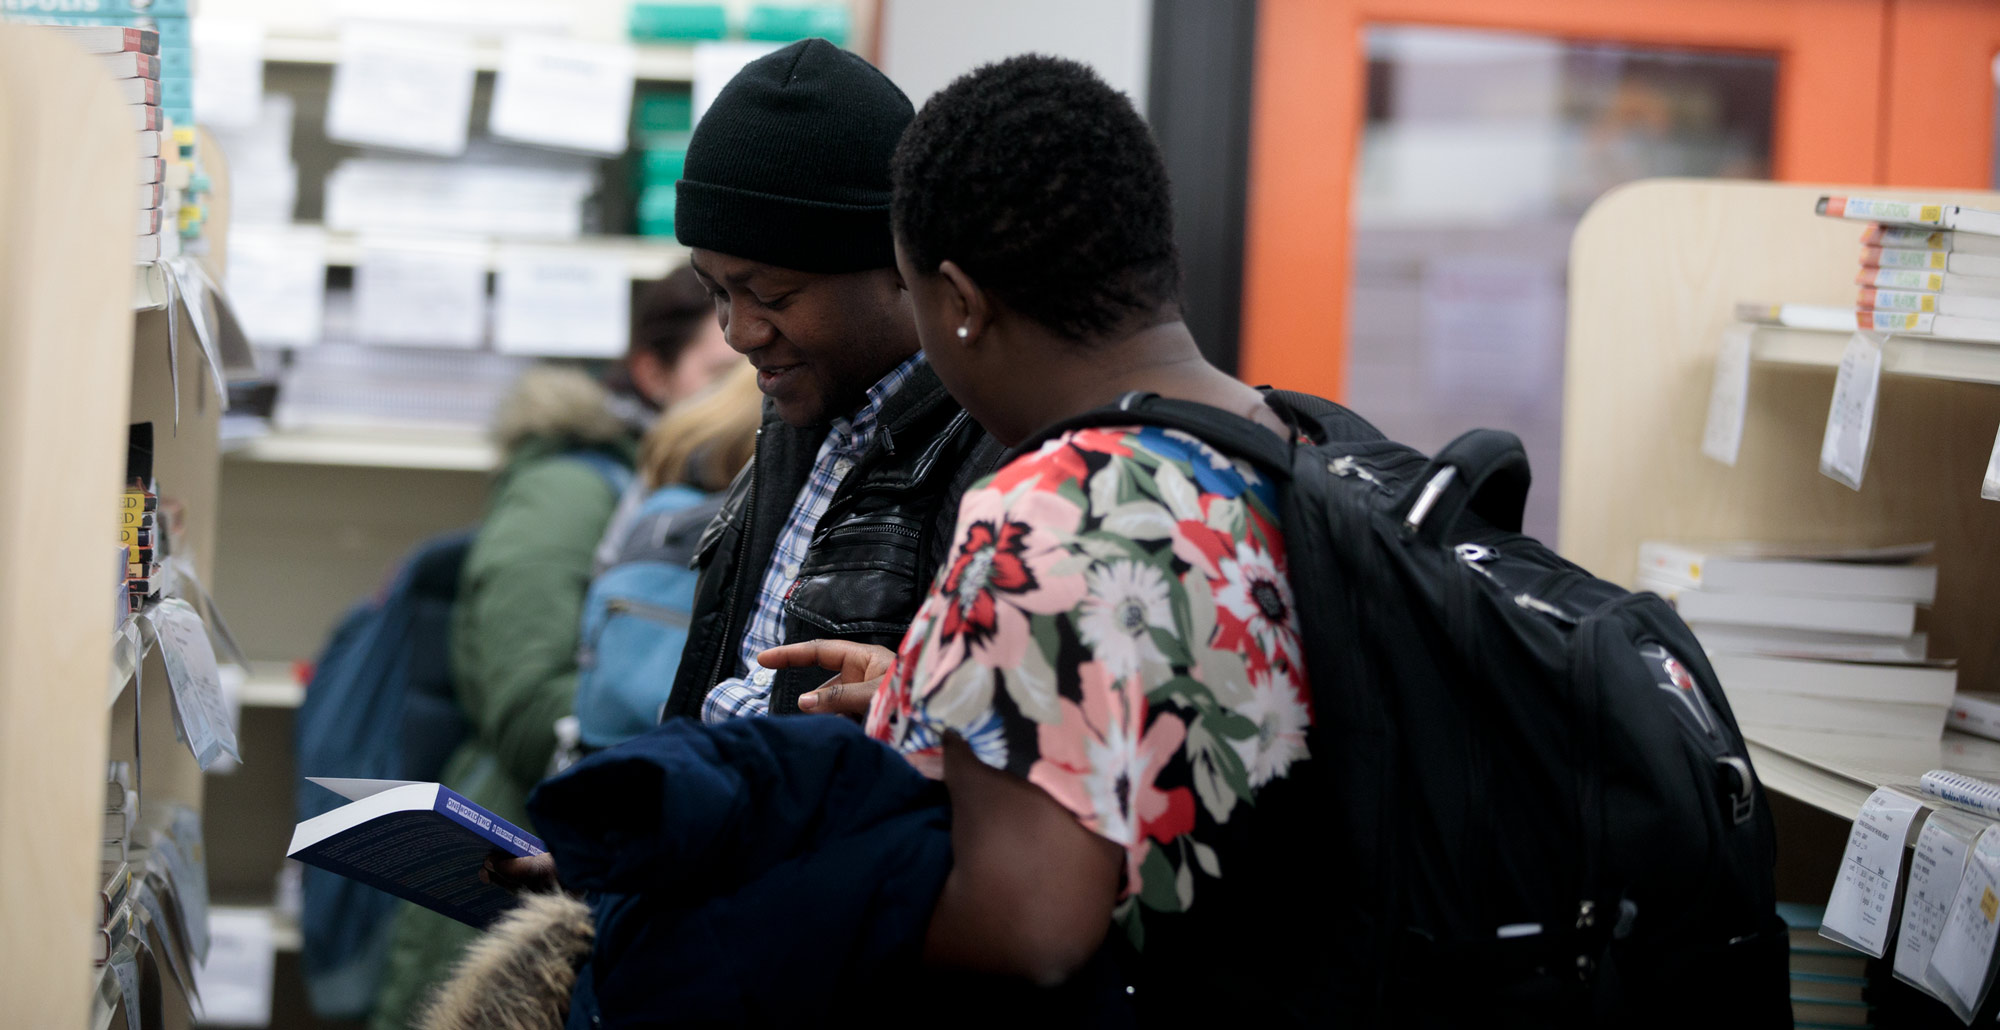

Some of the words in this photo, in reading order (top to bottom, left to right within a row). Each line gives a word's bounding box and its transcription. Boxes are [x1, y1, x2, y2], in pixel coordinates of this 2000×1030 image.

[447, 798, 461, 813] ONE
[459, 805, 479, 823] WORLD
[478, 815, 492, 830] TWO
